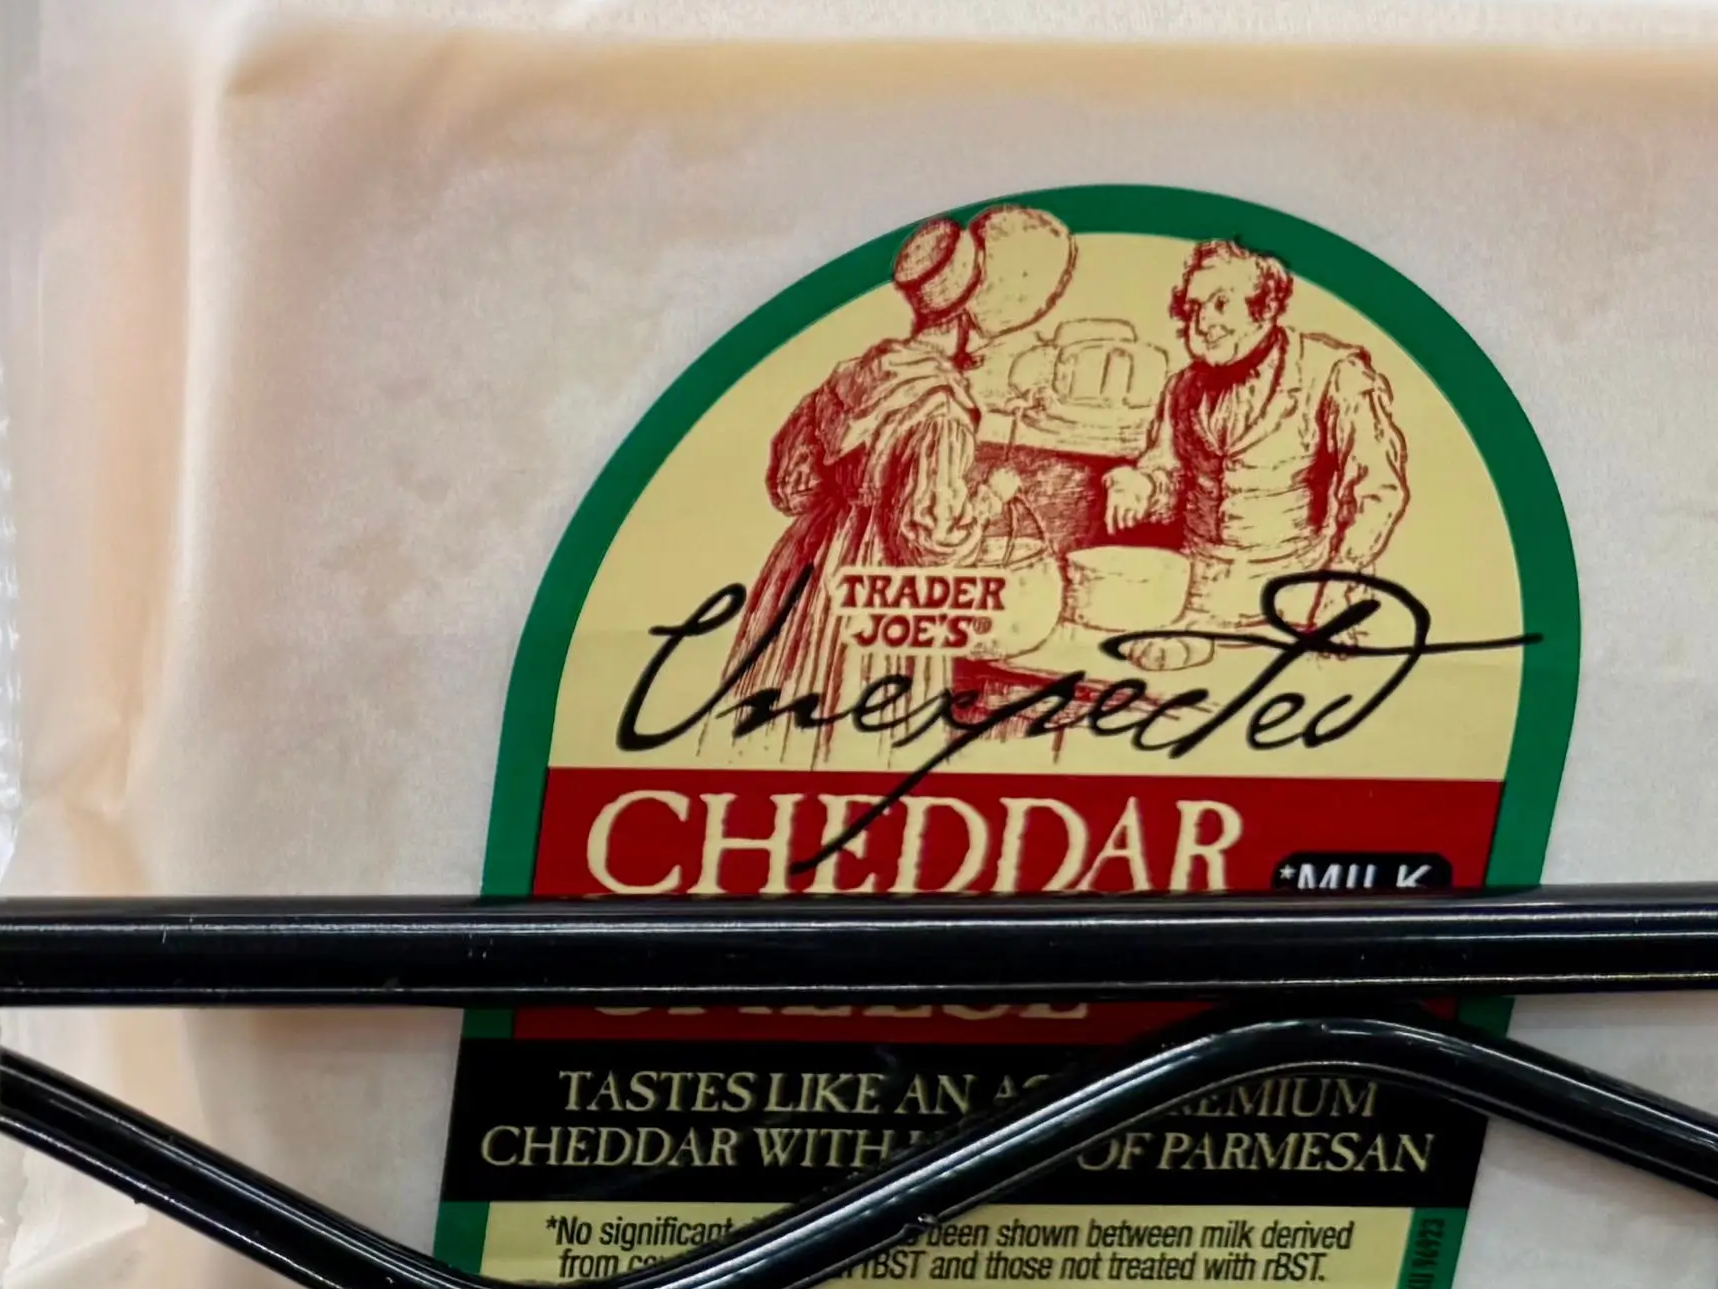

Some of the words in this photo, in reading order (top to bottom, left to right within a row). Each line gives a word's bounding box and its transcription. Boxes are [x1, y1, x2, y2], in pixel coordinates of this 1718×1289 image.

[835, 573, 1007, 611] TRADER
[615, 559, 1545, 876] Unexpected
[584, 786, 1247, 896] CHEDDAR
[559, 1069, 756, 1112] TASTES
[763, 1072, 886, 1114] LIKE
[894, 1073, 978, 1115] AN
[1168, 1077, 1378, 1117] EMIUM
[479, 1124, 741, 1168] CHEDDAR
[753, 1126, 895, 1169] WITH
[1076, 1131, 1150, 1172] OF
[1158, 1131, 1436, 1174] PARMESAN
[599, 1216, 735, 1252] significant
[926, 1222, 990, 1248] been
[996, 1218, 1082, 1249] shown
[1087, 1219, 1195, 1249] between
[1201, 1220, 1254, 1250] milk
[1260, 1220, 1355, 1251] derived
[558, 1248, 619, 1279] from
[930, 1250, 979, 1280] and
[986, 1251, 1052, 1280] those
[1060, 1253, 1104, 1281] not
[1108, 1252, 1196, 1281] treated
[1202, 1253, 1256, 1281] with
[1262, 1254, 1327, 1282] rBST.
